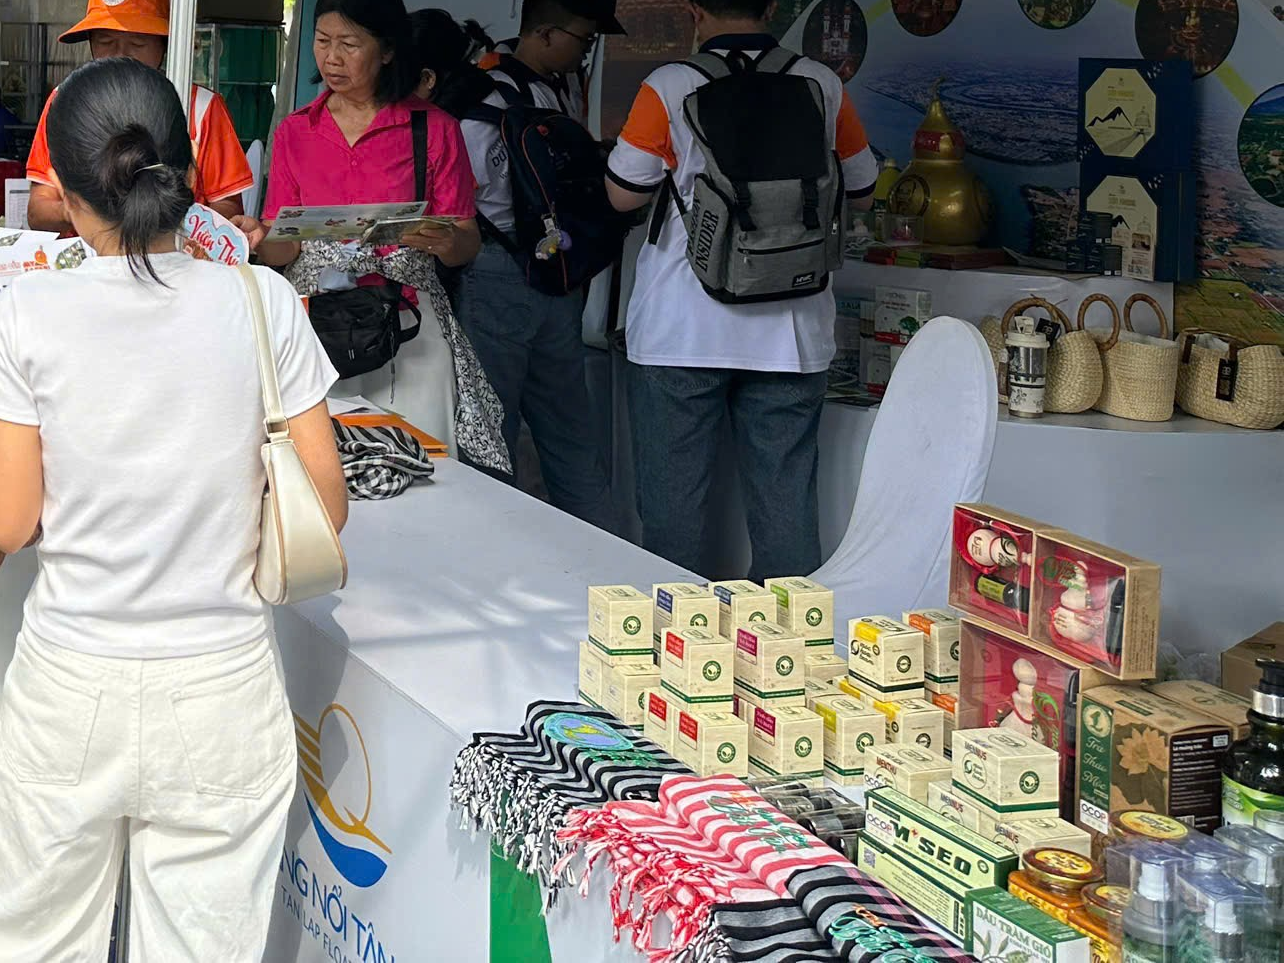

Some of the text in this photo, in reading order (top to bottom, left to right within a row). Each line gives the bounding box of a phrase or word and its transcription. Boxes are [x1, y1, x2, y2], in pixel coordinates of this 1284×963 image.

[695, 209, 720, 273] INSIDER
[866, 813, 893, 832] OCOP
[1081, 803, 1107, 820] OCOP
[280, 845, 308, 897] NG
[312, 872, 347, 941] NỔI
